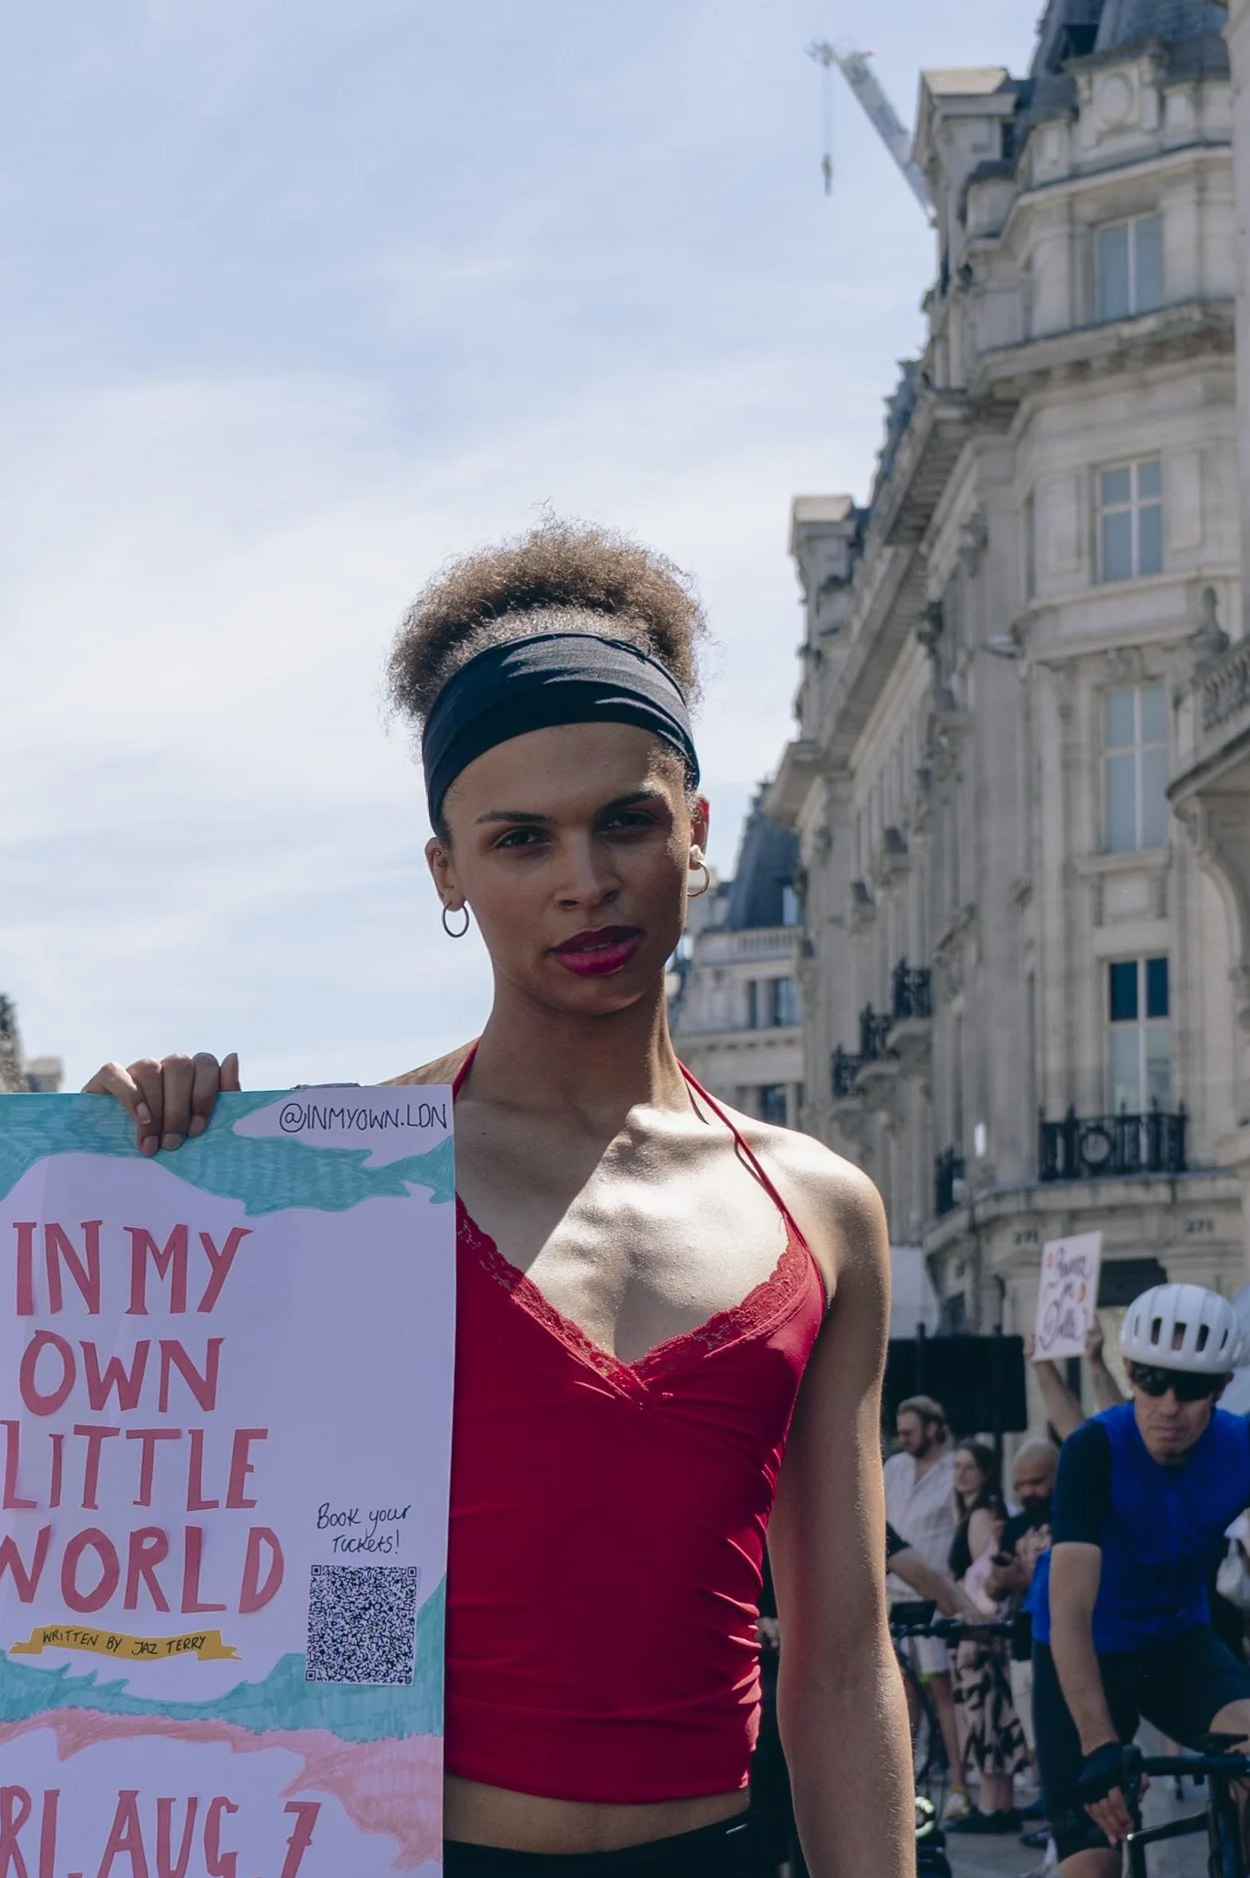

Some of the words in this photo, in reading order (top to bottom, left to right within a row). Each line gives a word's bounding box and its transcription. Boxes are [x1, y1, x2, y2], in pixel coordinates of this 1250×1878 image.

[278, 1102, 448, 1134] @INMYOWN.LDN
[13, 1220, 102, 1317] IN
[124, 1223, 253, 1316] MY
[18, 1329, 224, 1418] OWN
[0, 1419, 268, 1512] LITTLE
[316, 1502, 361, 1530] Book
[368, 1504, 412, 1540] your
[42, 1629, 100, 1646] WRITTEN
[105, 1635, 123, 1653] BY
[130, 1641, 159, 1656] JAZ
[165, 1635, 207, 1654] TERRY
